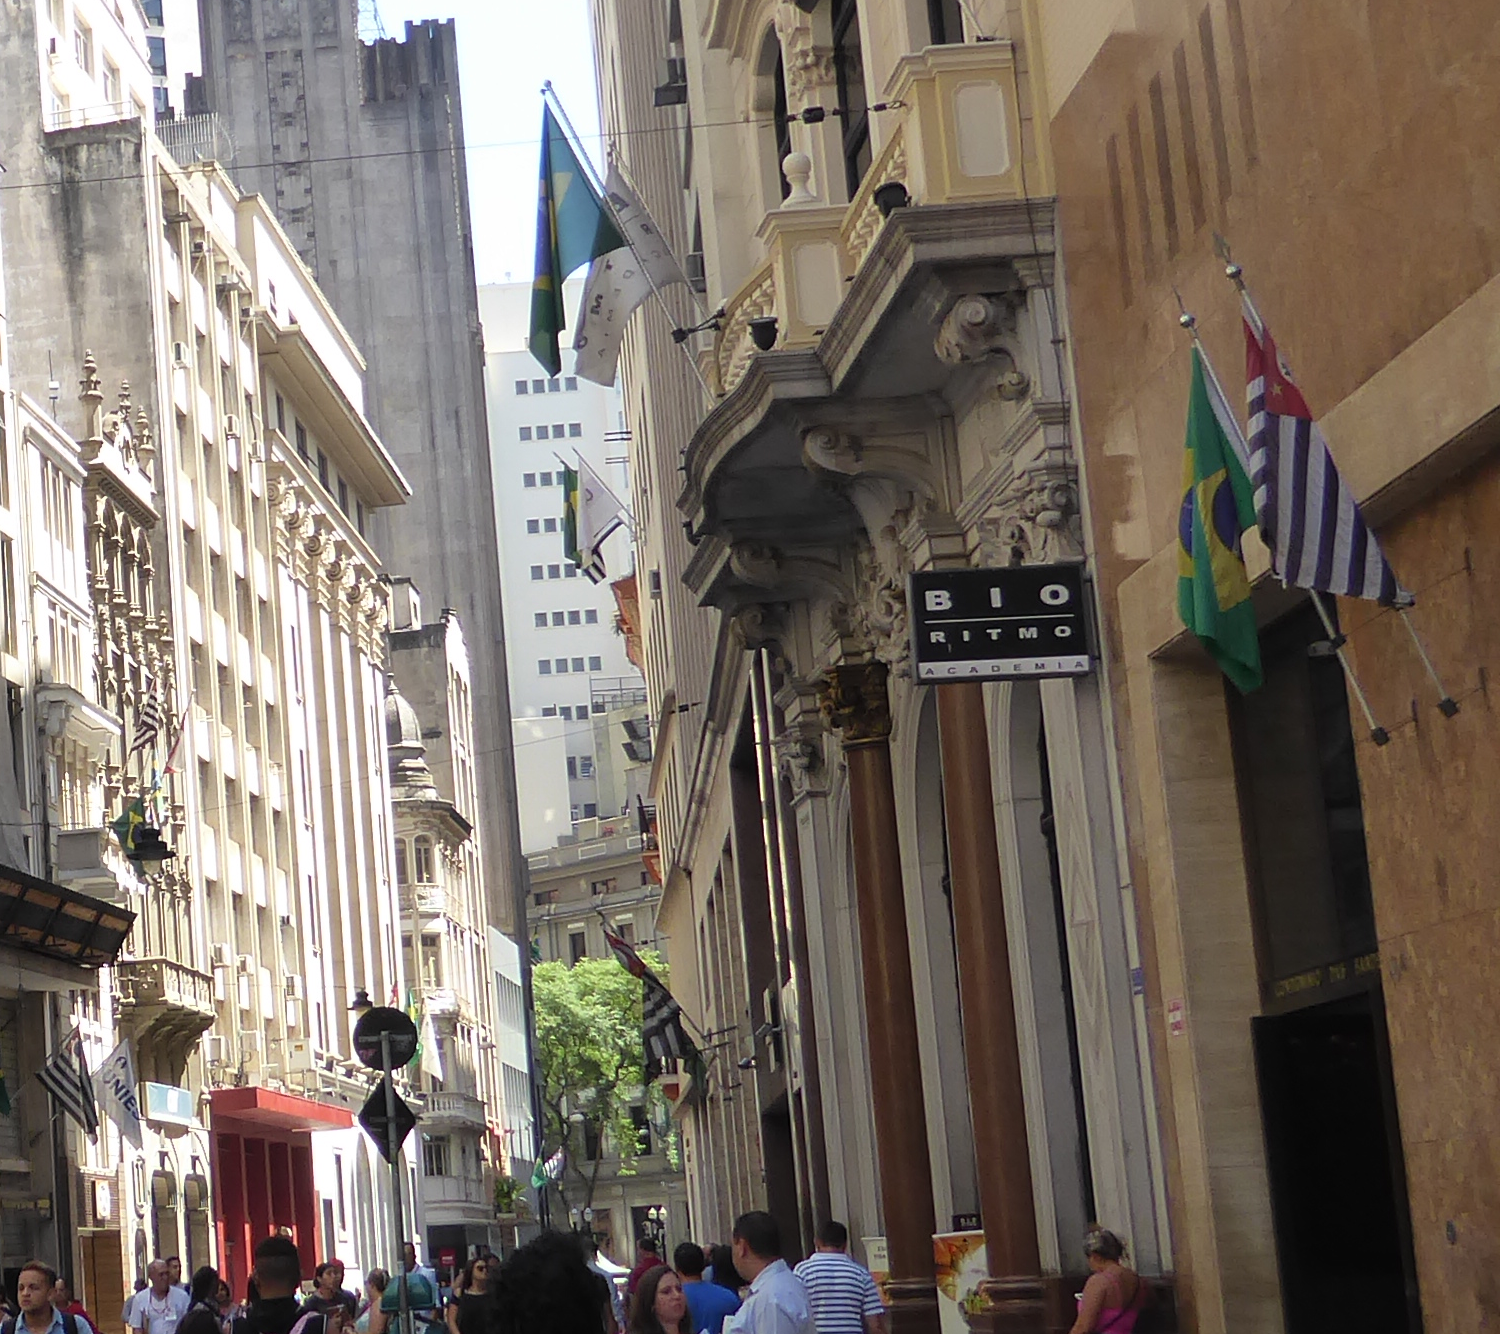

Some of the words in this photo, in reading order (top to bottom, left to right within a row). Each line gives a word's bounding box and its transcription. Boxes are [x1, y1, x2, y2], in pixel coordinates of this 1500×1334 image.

[925, 584, 1069, 611] BIO
[930, 625, 1072, 643] RITMO
[924, 661, 1084, 676] ACADEMIA
